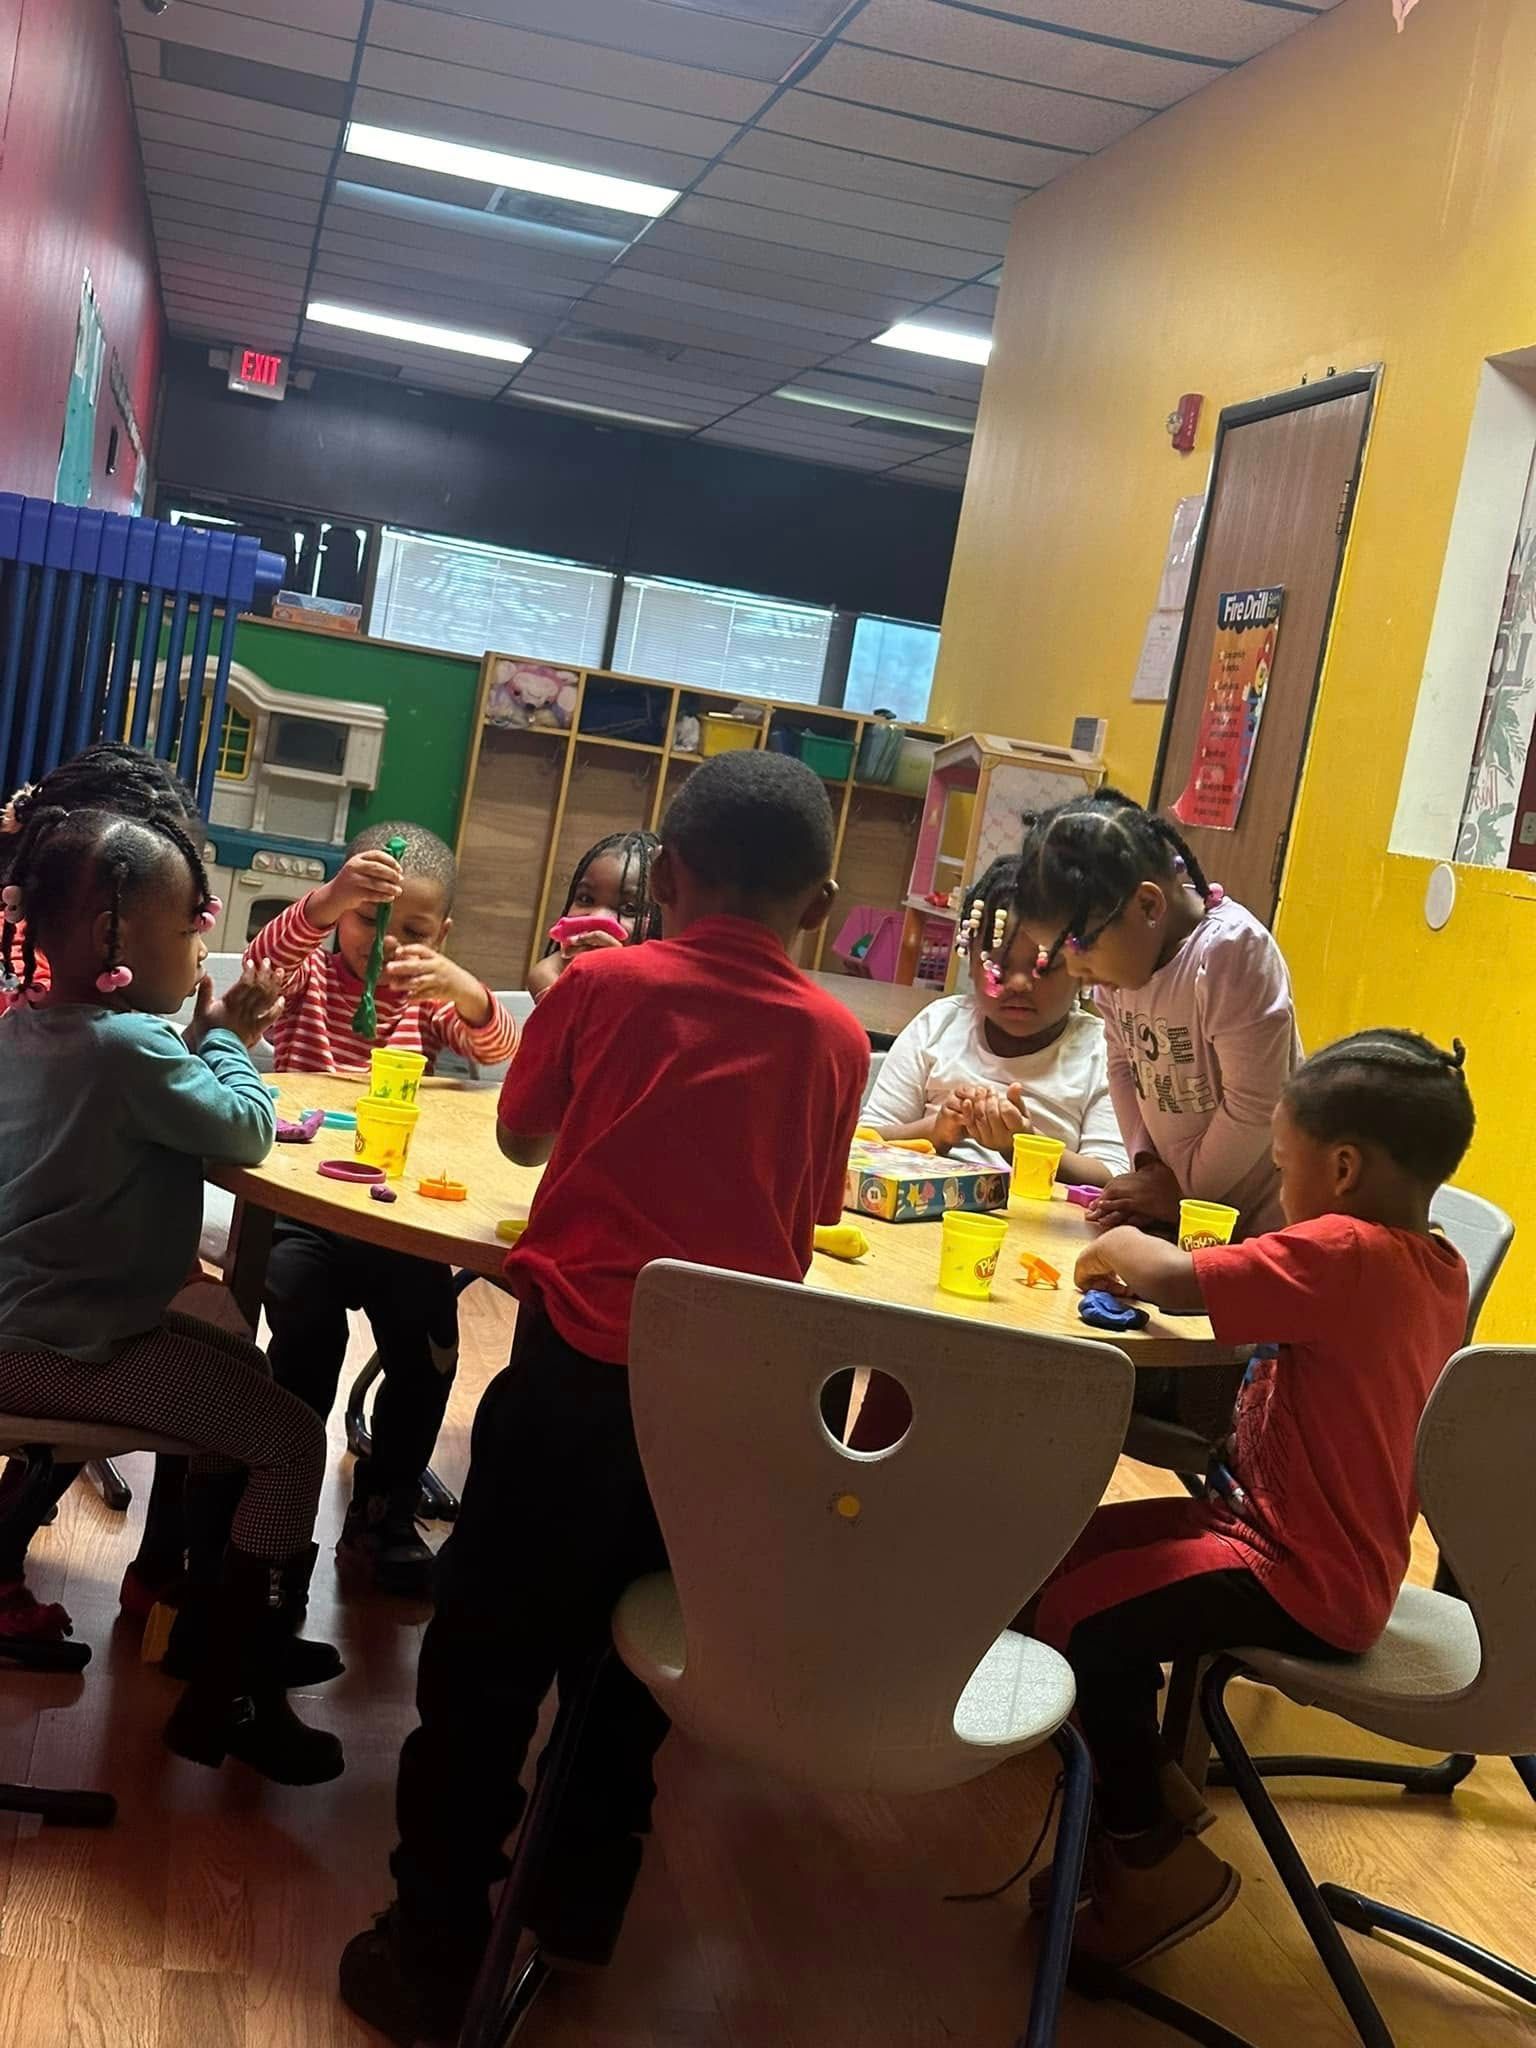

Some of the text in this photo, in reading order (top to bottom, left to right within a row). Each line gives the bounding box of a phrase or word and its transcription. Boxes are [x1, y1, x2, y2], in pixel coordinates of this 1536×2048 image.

[241, 351, 281, 385] EXIT
[1224, 594, 1244, 622] Fire
[1243, 592, 1268, 620] Drill
